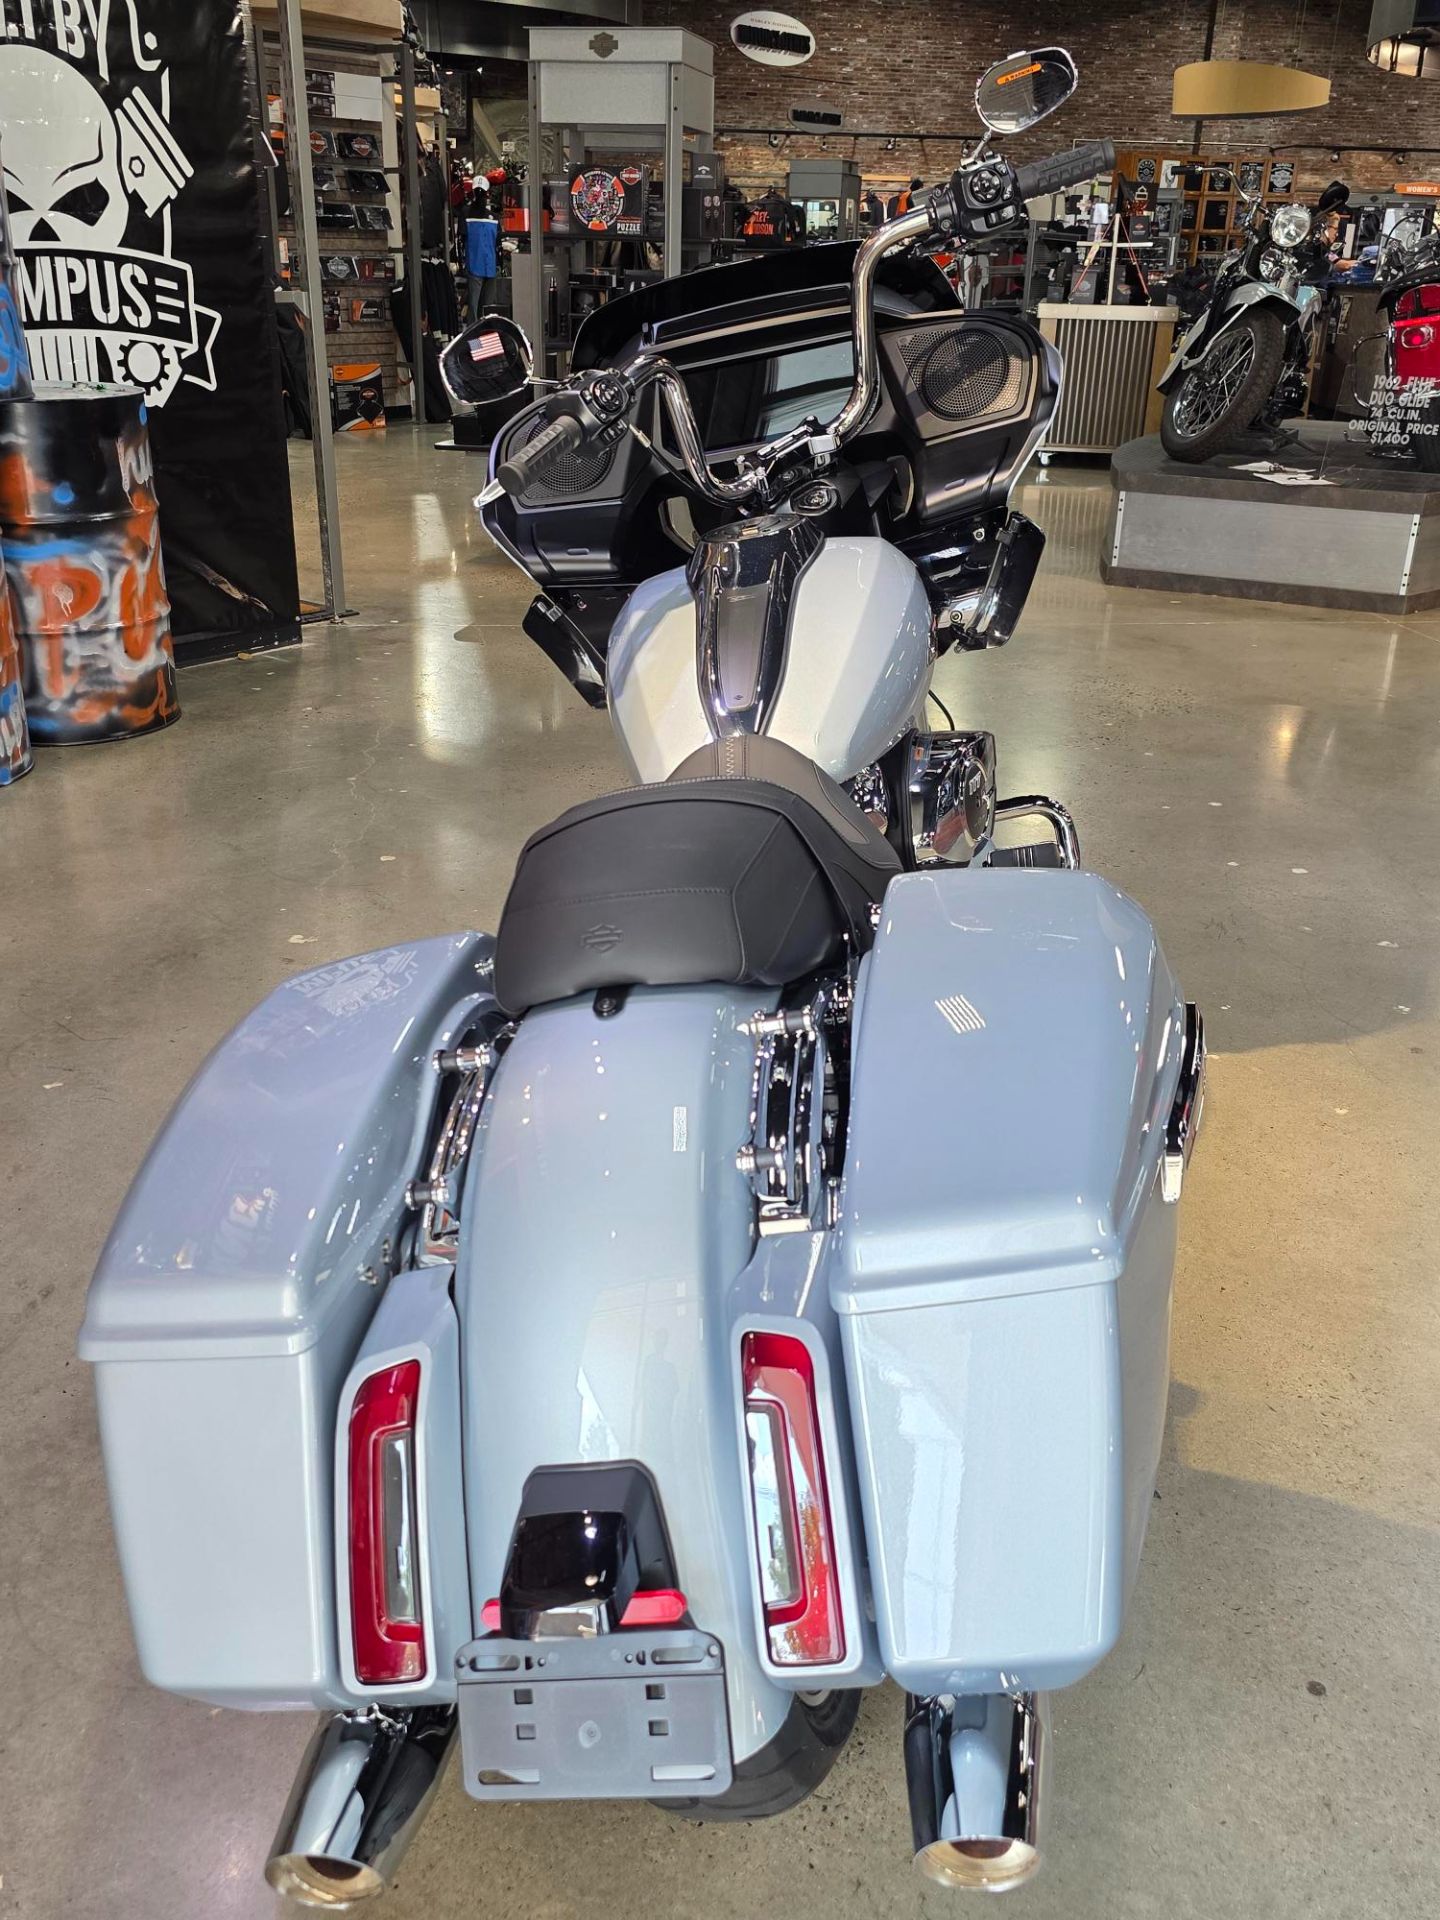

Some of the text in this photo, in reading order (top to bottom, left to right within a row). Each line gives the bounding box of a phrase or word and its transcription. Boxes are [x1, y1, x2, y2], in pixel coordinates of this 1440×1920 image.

[616, 223, 641, 231] PUZZLE
[17, 255, 151, 328] MPUS
[1373, 374, 1402, 390] 1962
[1369, 390, 1431, 408] DUO GLIDE
[1370, 407, 1383, 418] 74
[1348, 419, 1439, 436] ORIGINAL PRICE
[1370, 432, 1410, 445] $1,400
